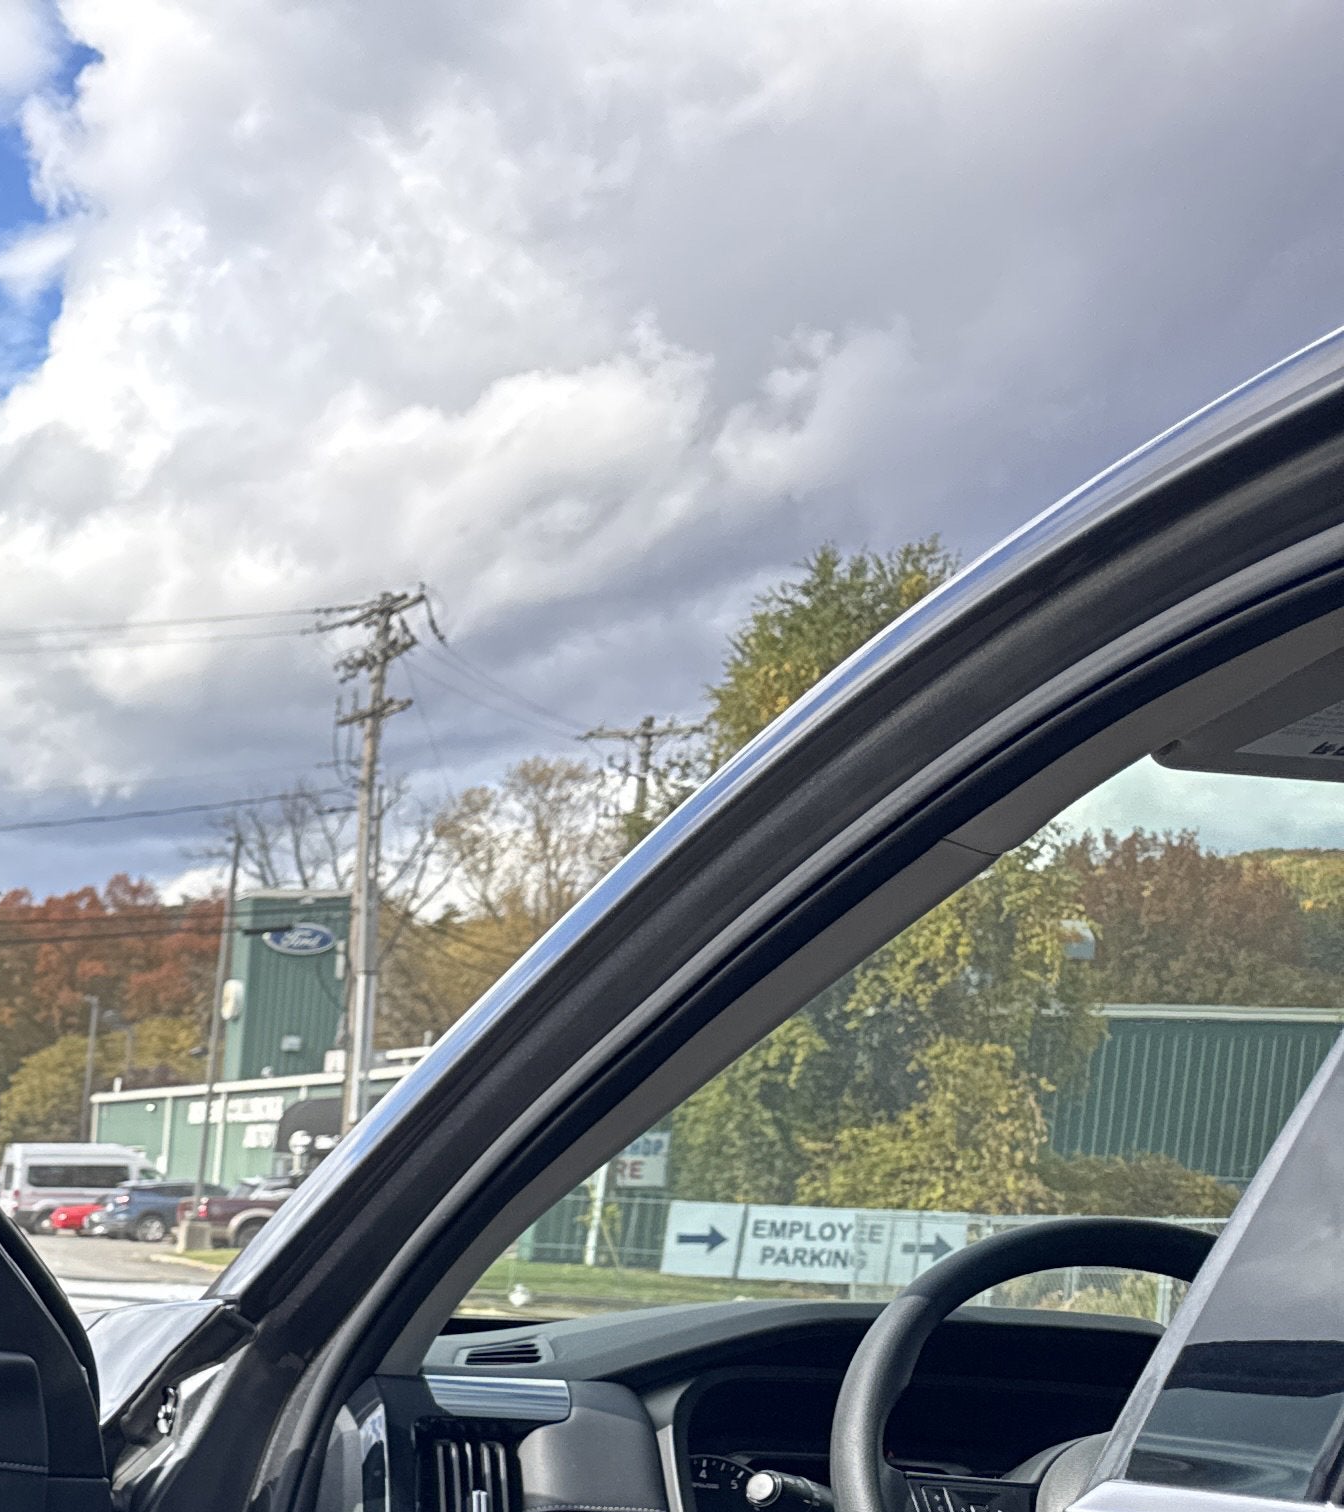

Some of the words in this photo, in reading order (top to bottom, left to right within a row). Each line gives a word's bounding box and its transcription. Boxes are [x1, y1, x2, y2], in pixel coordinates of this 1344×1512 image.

[752, 1218, 885, 1244] EMPLOYEE
[760, 1245, 867, 1270] PARKING
[699, 1469, 707, 1479] 4
[730, 1479, 738, 1490] 5
